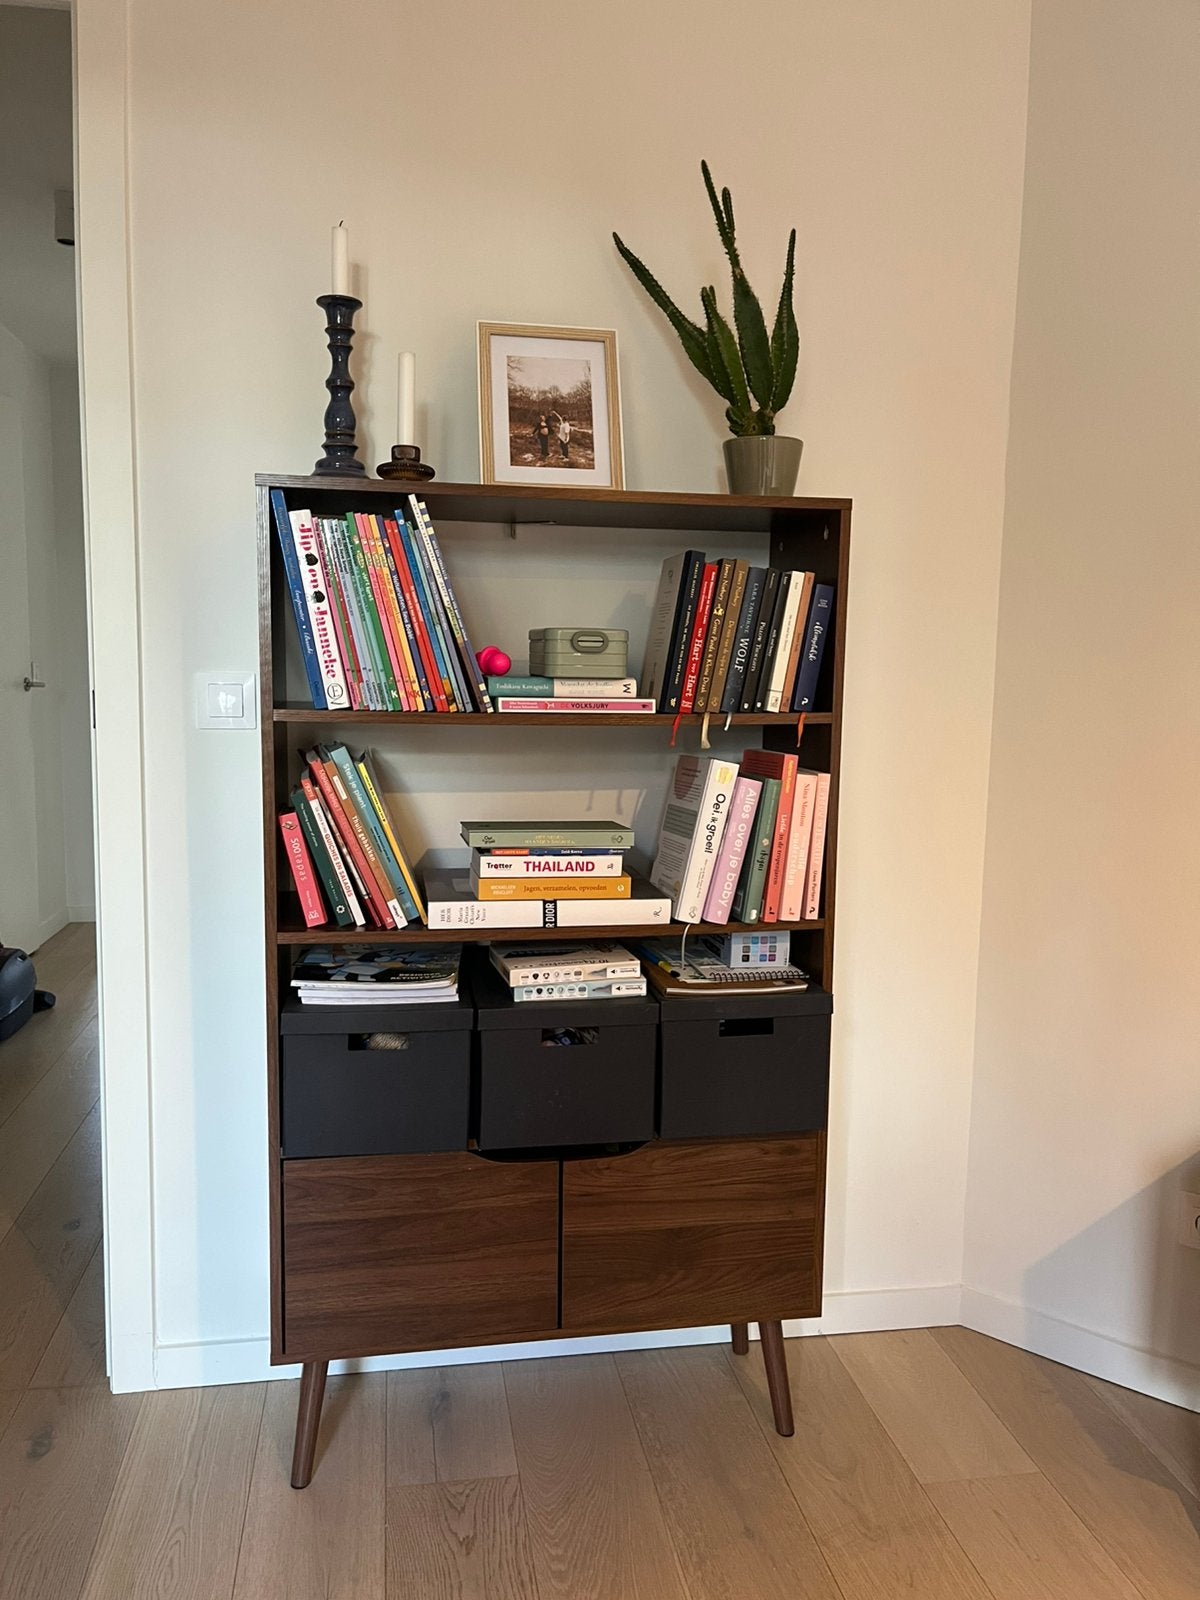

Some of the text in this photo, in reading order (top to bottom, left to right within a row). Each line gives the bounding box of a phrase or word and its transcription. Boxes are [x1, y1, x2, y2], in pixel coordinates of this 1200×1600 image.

[717, 563, 731, 601] James Norbury
[730, 570, 744, 607] James Norbury
[297, 522, 314, 551] Jip
[308, 567, 319, 589] en
[315, 605, 337, 678] Janneke
[692, 638, 702, 661] Hart
[708, 635, 717, 653] Panda
[734, 636, 748, 673] WOLF
[685, 674, 695, 697] Hart
[700, 676, 709, 694] Draak
[342, 762, 366, 809] Stek je plant
[802, 782, 810, 799] Nina
[741, 787, 756, 820] Alles
[710, 816, 718, 824] ik
[358, 831, 376, 862] gebakken
[701, 823, 717, 854] groei!
[733, 822, 746, 852] over
[771, 814, 787, 885] Liefde in de tropenjaren
[290, 836, 307, 881] 500 tapas
[324, 832, 352, 897] QUICHES EN SALADES
[523, 861, 595, 872] THAILAND
[727, 854, 740, 869] je
[787, 832, 801, 886] ouderschap
[523, 885, 541, 893] Jagen,
[578, 884, 607, 892] opvoeden
[718, 871, 735, 907] baby
[545, 902, 555, 922] DIOR
